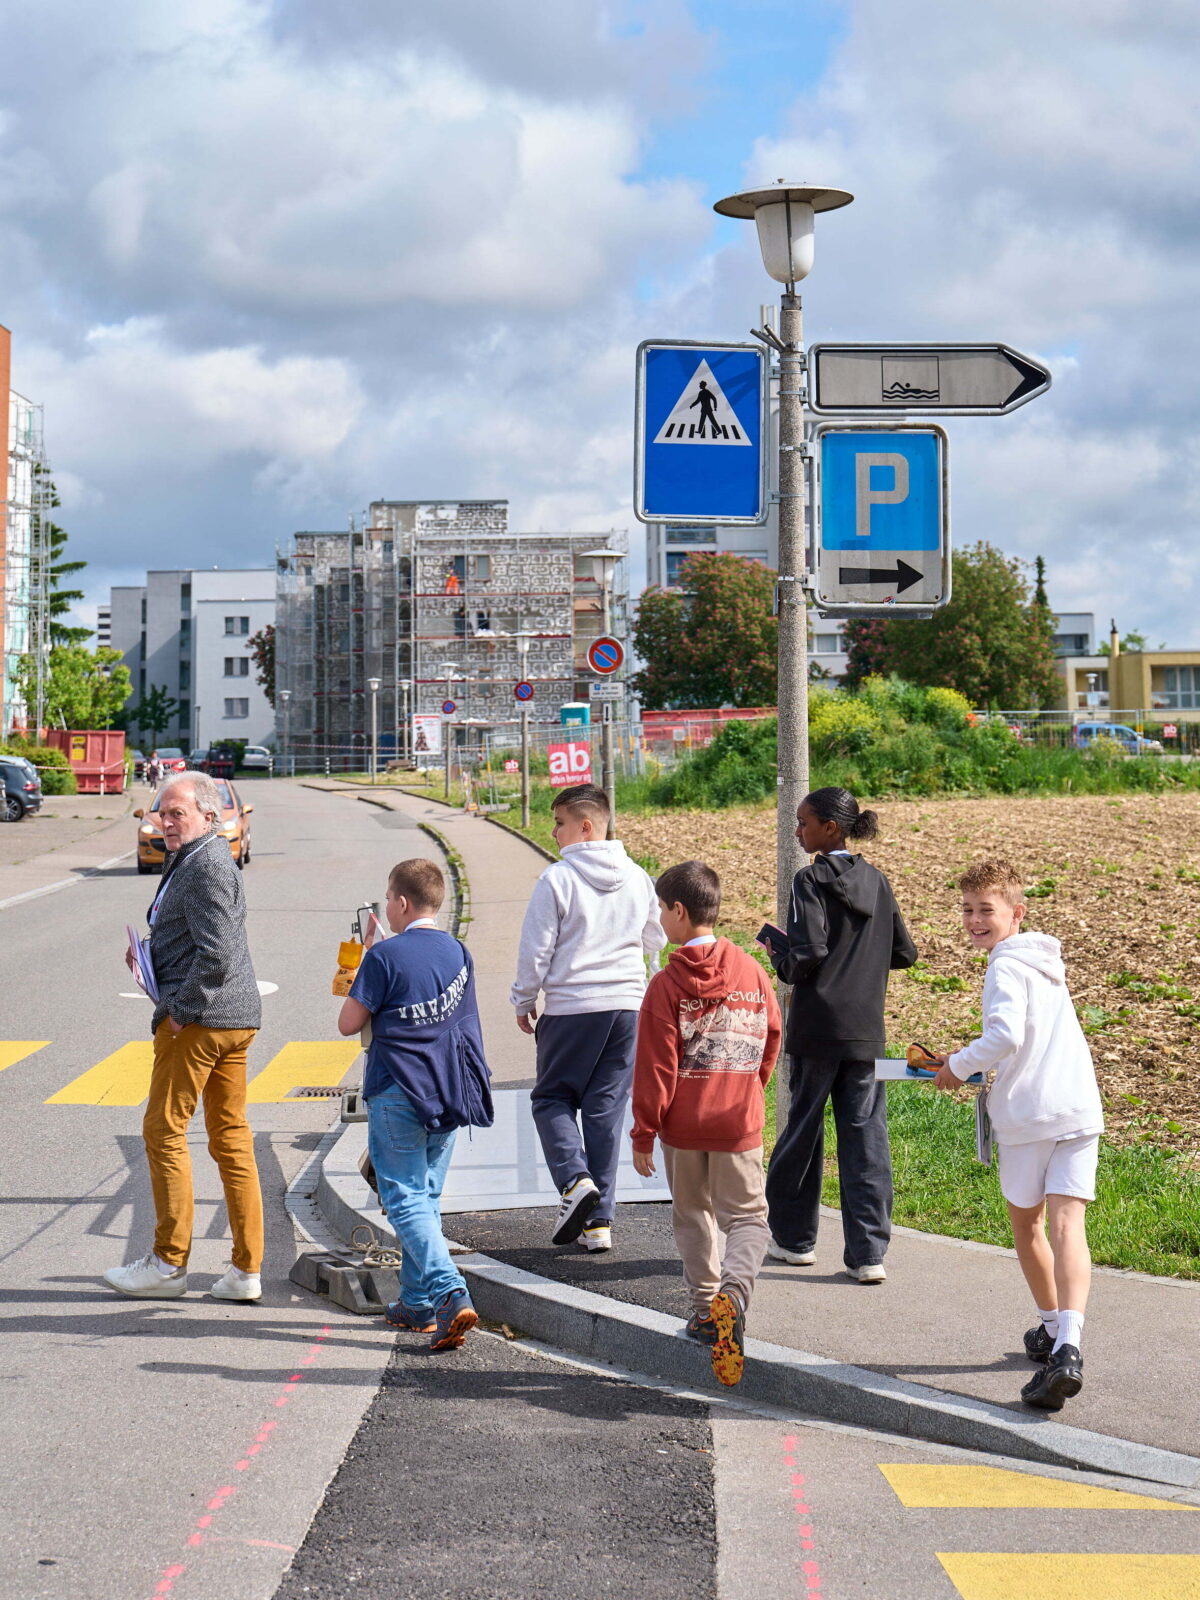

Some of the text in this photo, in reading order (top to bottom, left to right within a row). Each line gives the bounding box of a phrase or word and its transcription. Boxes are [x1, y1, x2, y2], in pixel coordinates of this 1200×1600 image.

[855, 452, 909, 536] P
[505, 760, 519, 769] ab
[549, 743, 590, 774] ab
[414, 1014, 445, 1026] FALLS
